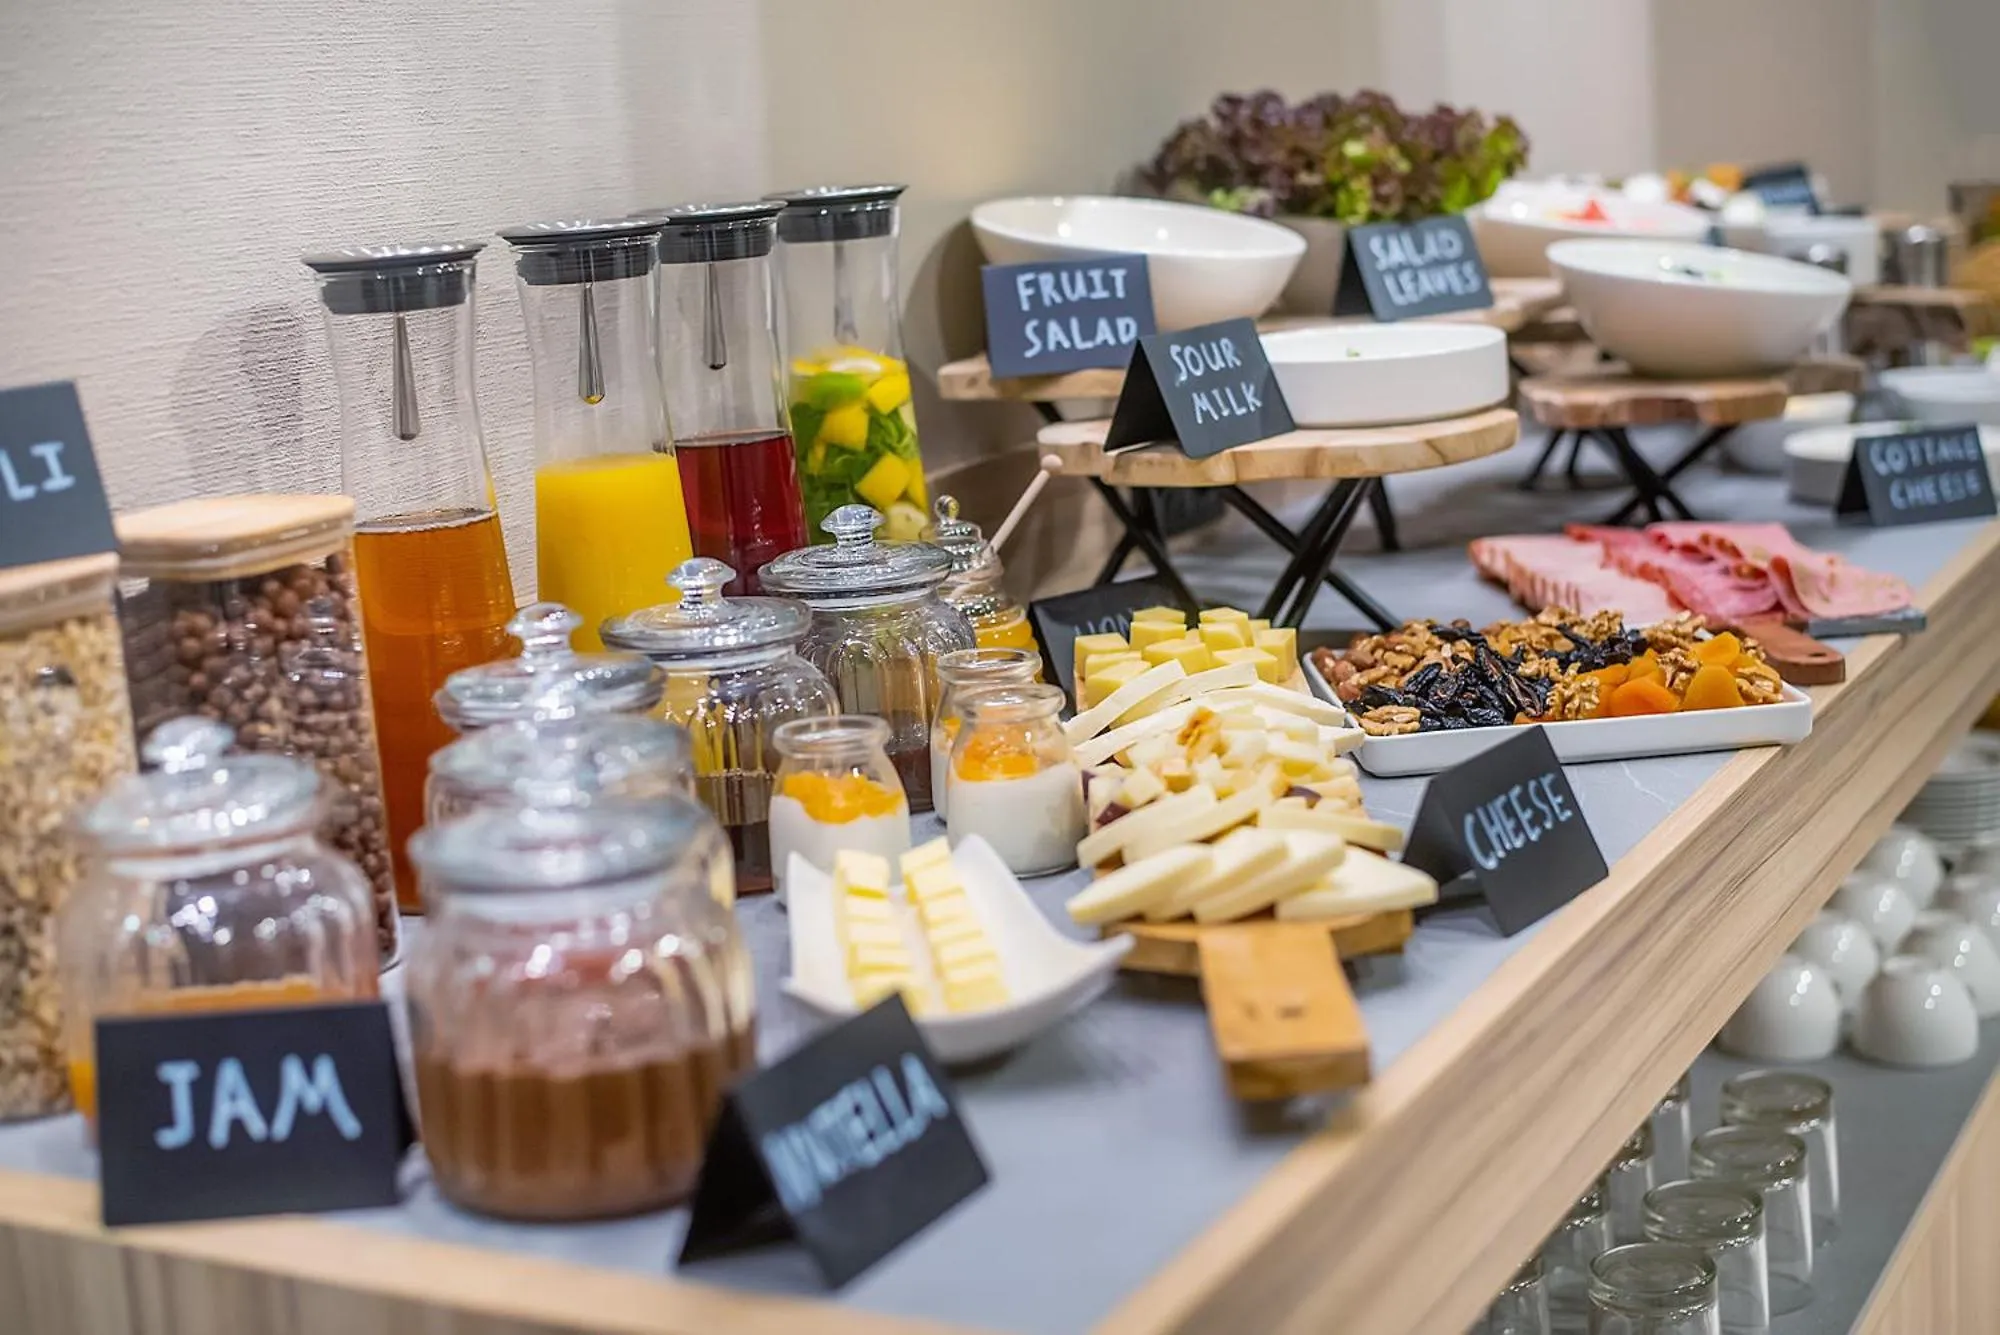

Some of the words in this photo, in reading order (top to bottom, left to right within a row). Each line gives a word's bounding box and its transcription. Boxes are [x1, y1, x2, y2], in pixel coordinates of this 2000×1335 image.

[1369, 229, 1463, 271] SALAD
[1017, 268, 1128, 311] FRUIT
[1382, 260, 1481, 306] LEAVES
[1023, 315, 1138, 359] SALAD
[1169, 337, 1242, 385] SOUR
[1191, 381, 1262, 424] MILK
[1463, 773, 1573, 870] CHEESE
[153, 1052, 363, 1150] JAM
